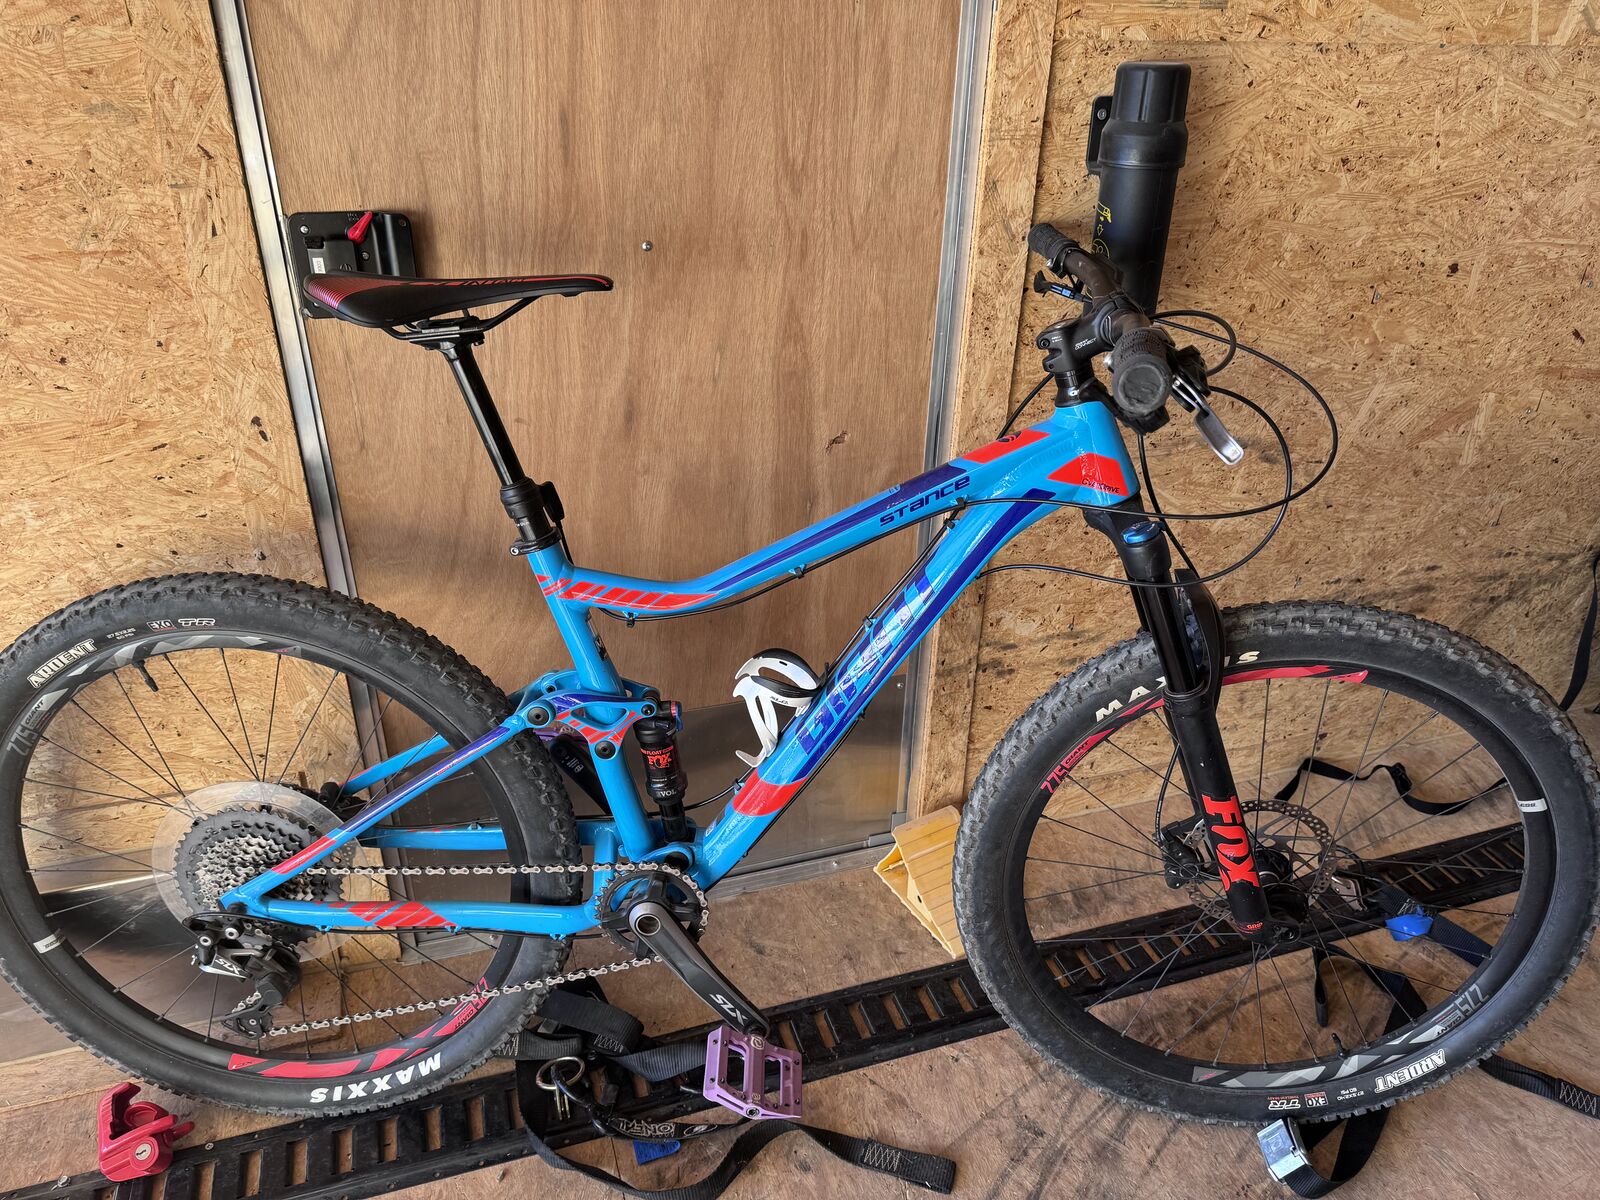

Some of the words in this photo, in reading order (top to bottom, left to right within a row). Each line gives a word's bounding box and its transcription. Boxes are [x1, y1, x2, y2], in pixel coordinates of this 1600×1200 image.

[147, 619, 174, 631] EXO
[178, 618, 216, 627] TR
[794, 546, 939, 757] GIANT
[26, 638, 98, 689] ARDENT
[25, 698, 44, 725] GIANT
[647, 753, 672, 769] FOX
[1065, 740, 1089, 764] GIANT
[1202, 794, 1260, 891] FOX
[214, 958, 242, 975] SLX
[455, 1009, 475, 1029] GIANT
[709, 992, 749, 1026] SLX
[1436, 1015, 1462, 1036] GIANT
[309, 1051, 442, 1103] MAXXIS
[1374, 1049, 1446, 1093] ARDENT
[1268, 1099, 1301, 1111] TR
[1305, 1096, 1328, 1108] EXO
